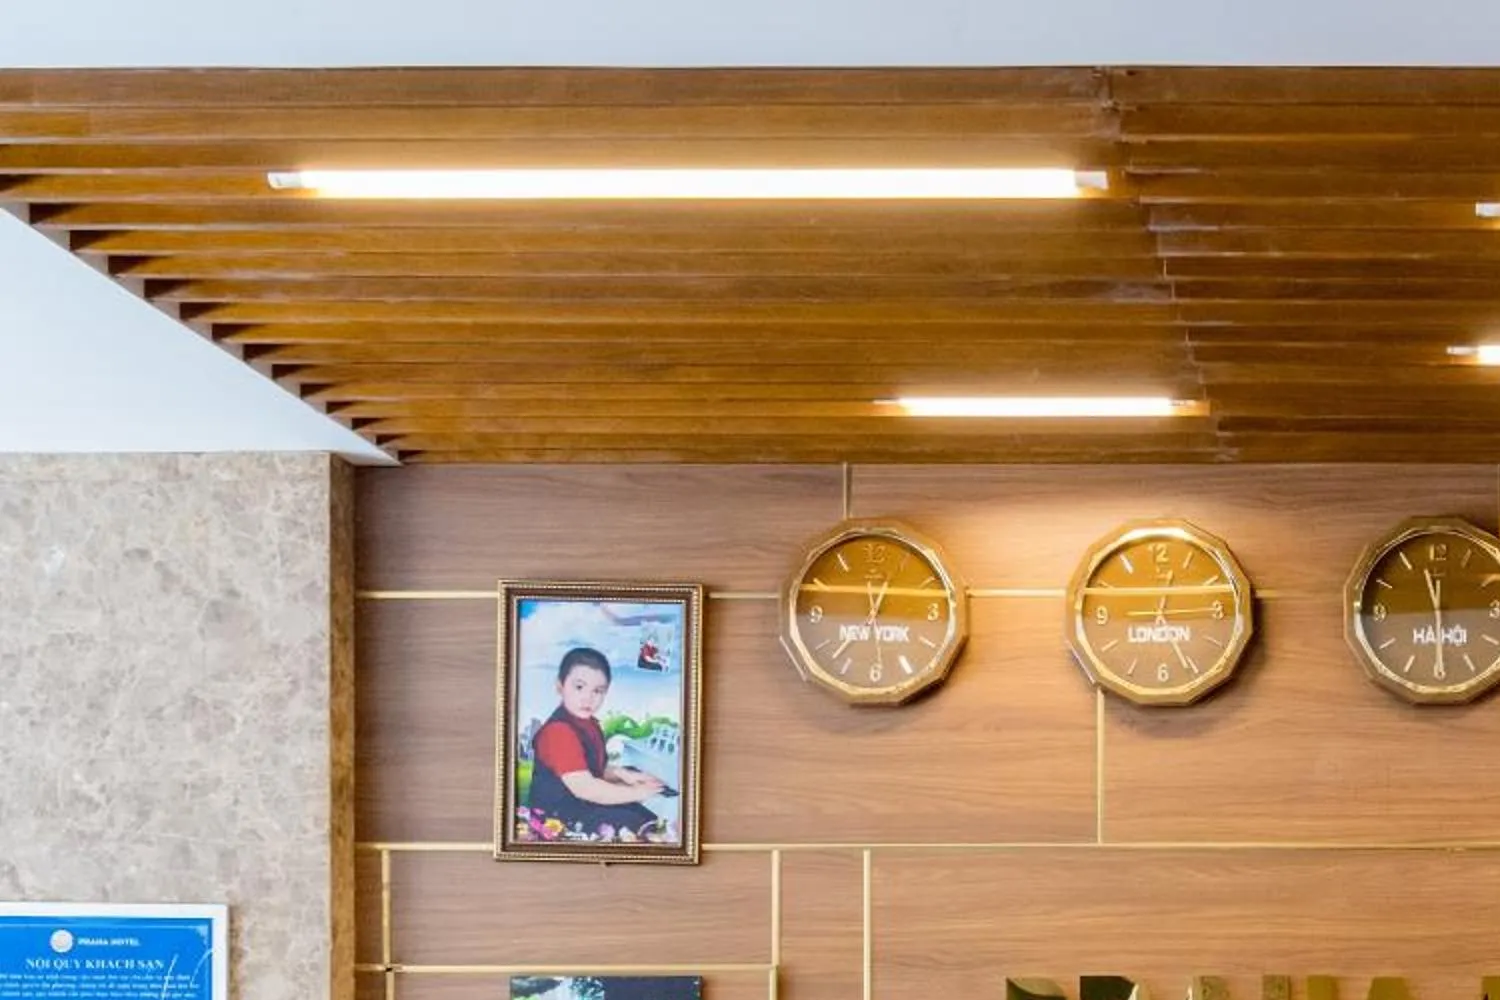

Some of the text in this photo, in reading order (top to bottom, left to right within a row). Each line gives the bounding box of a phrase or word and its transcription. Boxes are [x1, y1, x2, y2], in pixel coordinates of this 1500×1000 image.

[1148, 544, 1168, 562] 12
[810, 605, 823, 623] 9
[927, 602, 939, 621] 3
[1096, 606, 1108, 625] 9
[1373, 605, 1386, 622] 9
[1489, 600, 1500, 619] 3
[839, 625, 910, 642] NEW YORK
[1127, 626, 1191, 643] LONDON
[870, 664, 882, 682] 6
[1157, 663, 1169, 682] 6
